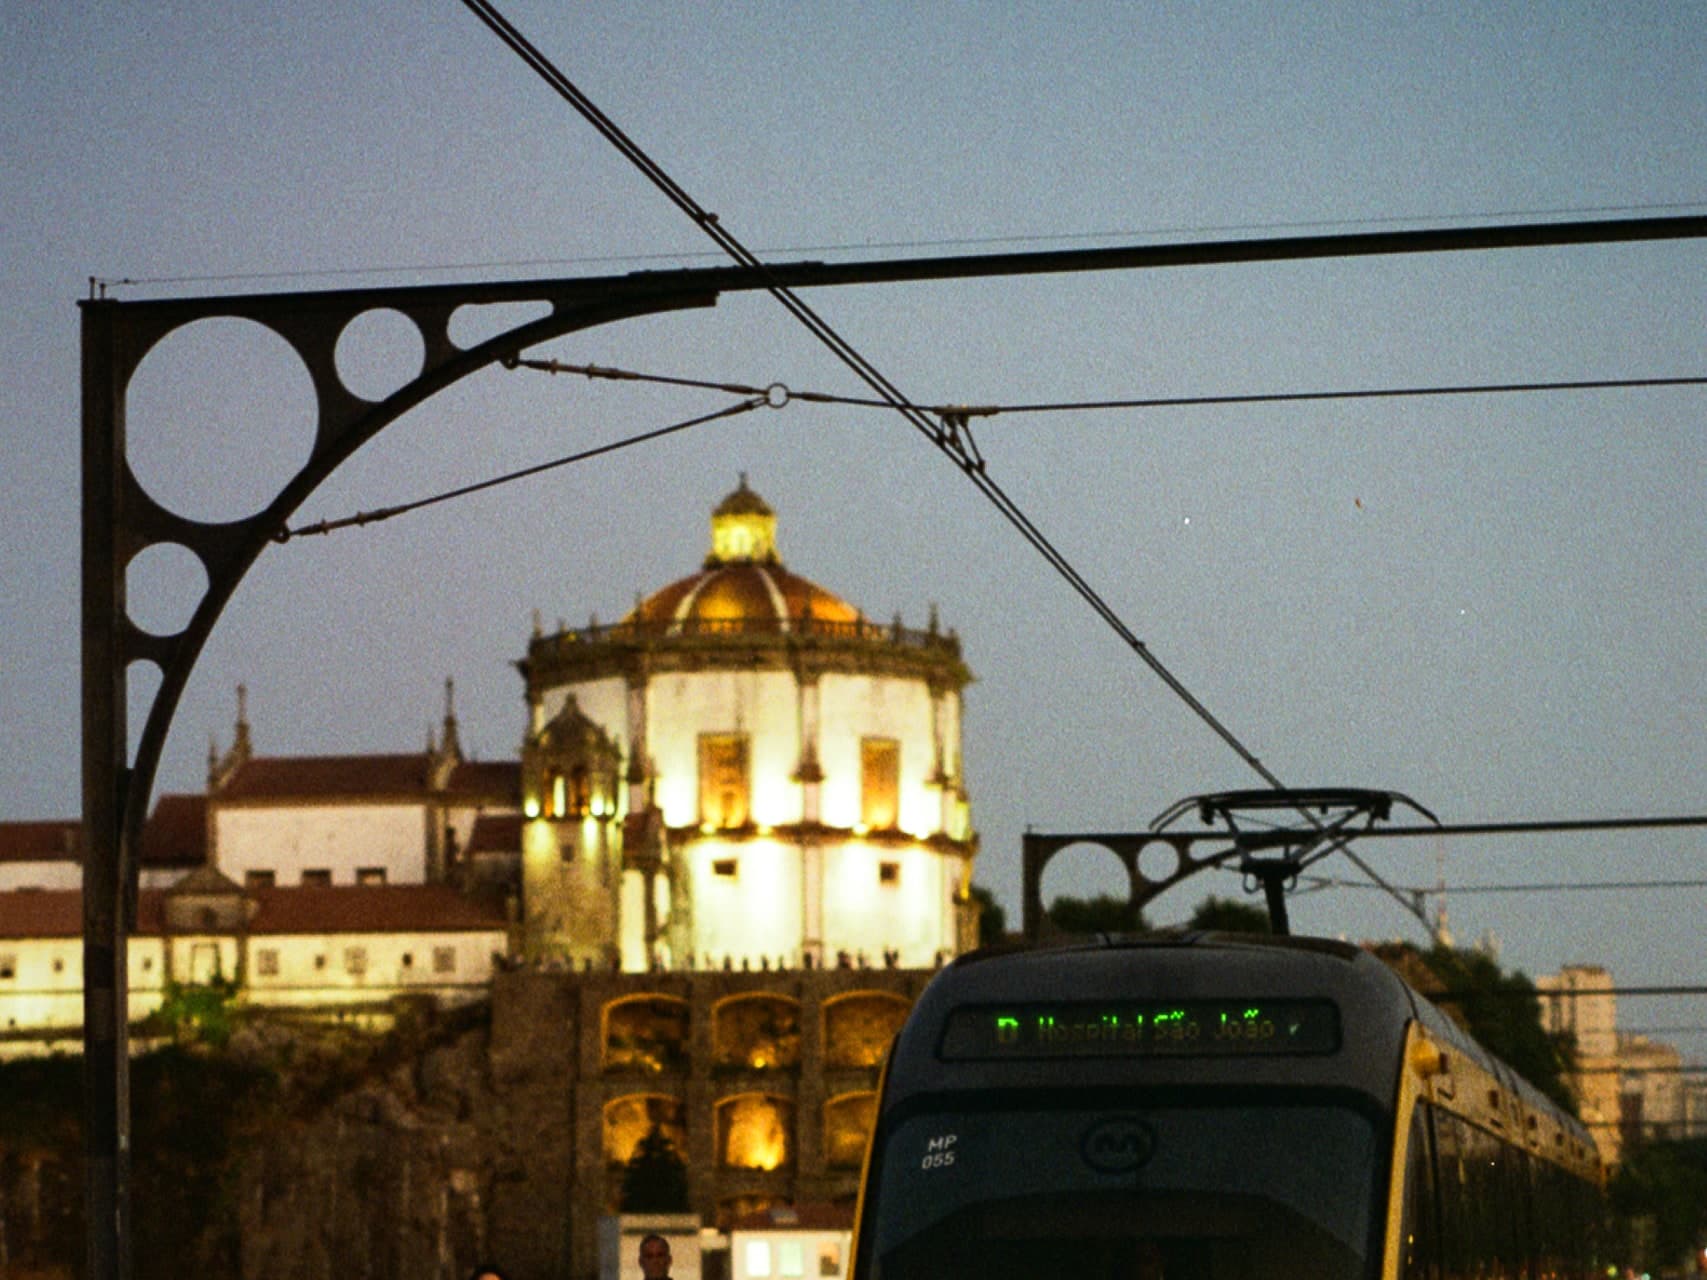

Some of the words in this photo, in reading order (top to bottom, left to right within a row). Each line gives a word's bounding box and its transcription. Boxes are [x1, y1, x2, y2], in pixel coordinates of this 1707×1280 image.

[1038, 1016, 1143, 1041] Hospital
[1154, 1010, 1201, 1041] São
[1214, 1009, 1276, 1041] João
[928, 1135, 957, 1151] MP
[921, 1152, 955, 1169] 055
